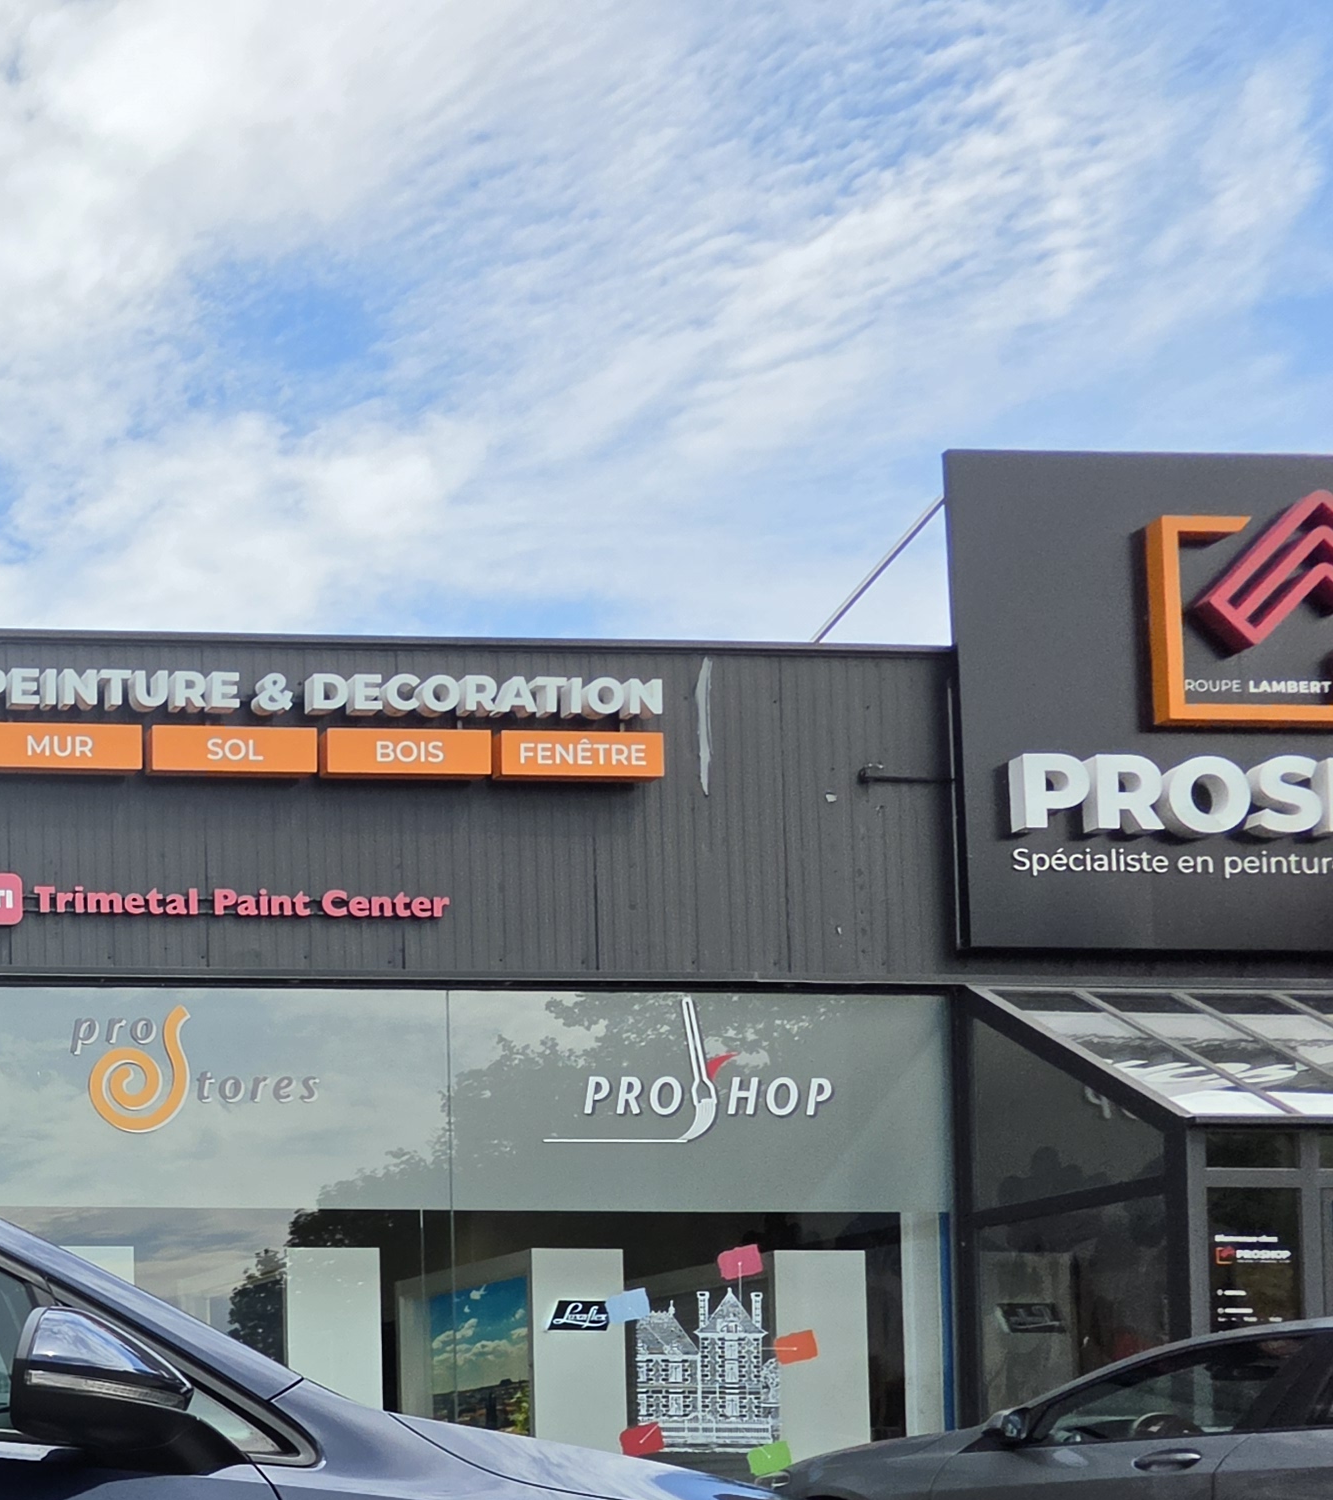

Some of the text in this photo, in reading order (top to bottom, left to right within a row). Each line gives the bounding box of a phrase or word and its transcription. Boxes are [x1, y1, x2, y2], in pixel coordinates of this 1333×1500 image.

[252, 673, 294, 714] &
[305, 672, 663, 719] DECORATION
[1184, 679, 1332, 693] ROUPE LAMBERT
[25, 734, 93, 758] MUR
[206, 737, 264, 762] SOL
[375, 740, 444, 763] BOIS
[519, 738, 647, 767] FENÊTRE
[1008, 753, 1333, 835] PROS
[1012, 847, 1333, 878] Spécialiste en peintur
[33, 885, 200, 916] Trimetal
[213, 888, 311, 918] Paint
[322, 889, 450, 919] Center
[70, 1015, 157, 1056] pro
